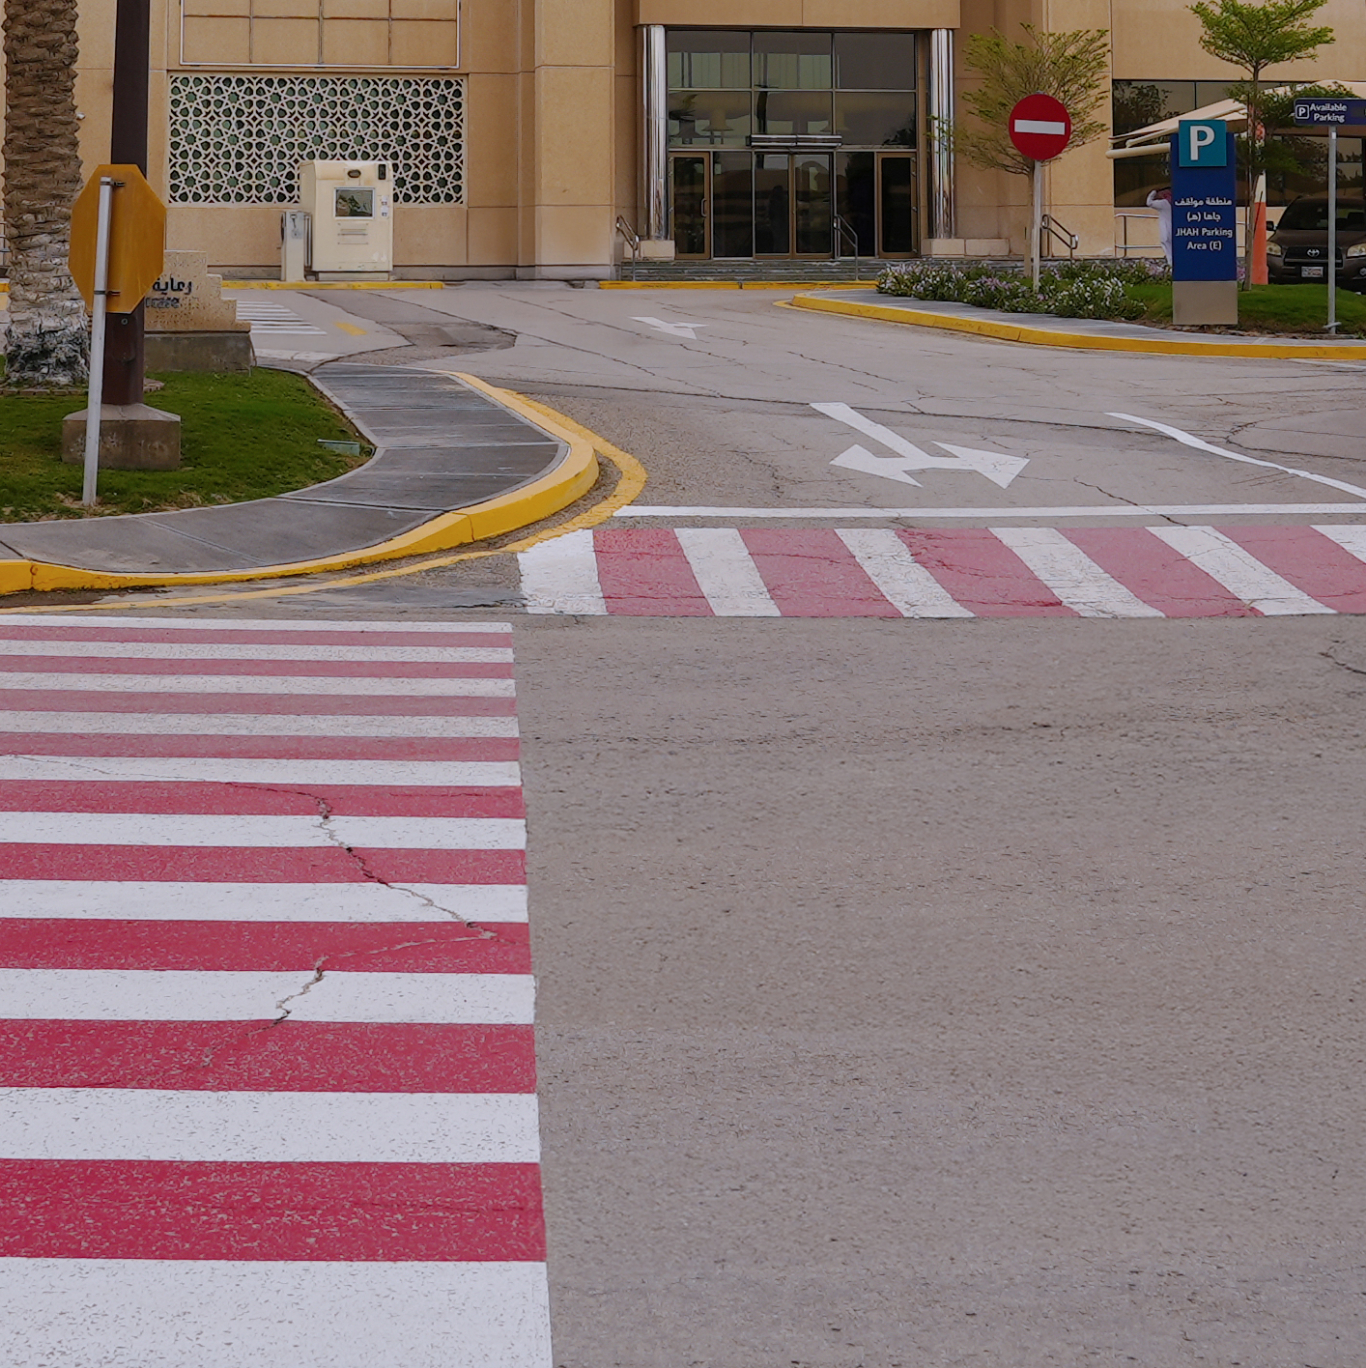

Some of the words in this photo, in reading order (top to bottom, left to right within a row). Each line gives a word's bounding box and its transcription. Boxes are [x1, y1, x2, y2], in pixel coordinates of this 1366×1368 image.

[1310, 103, 1348, 112] Available
[1314, 113, 1345, 123] Parking
[1189, 125, 1215, 161] P
[1175, 228, 1199, 237] JHAH
[1201, 227, 1233, 239] Parking
[1186, 241, 1207, 250] Area
[1209, 239, 1222, 251] (E)
